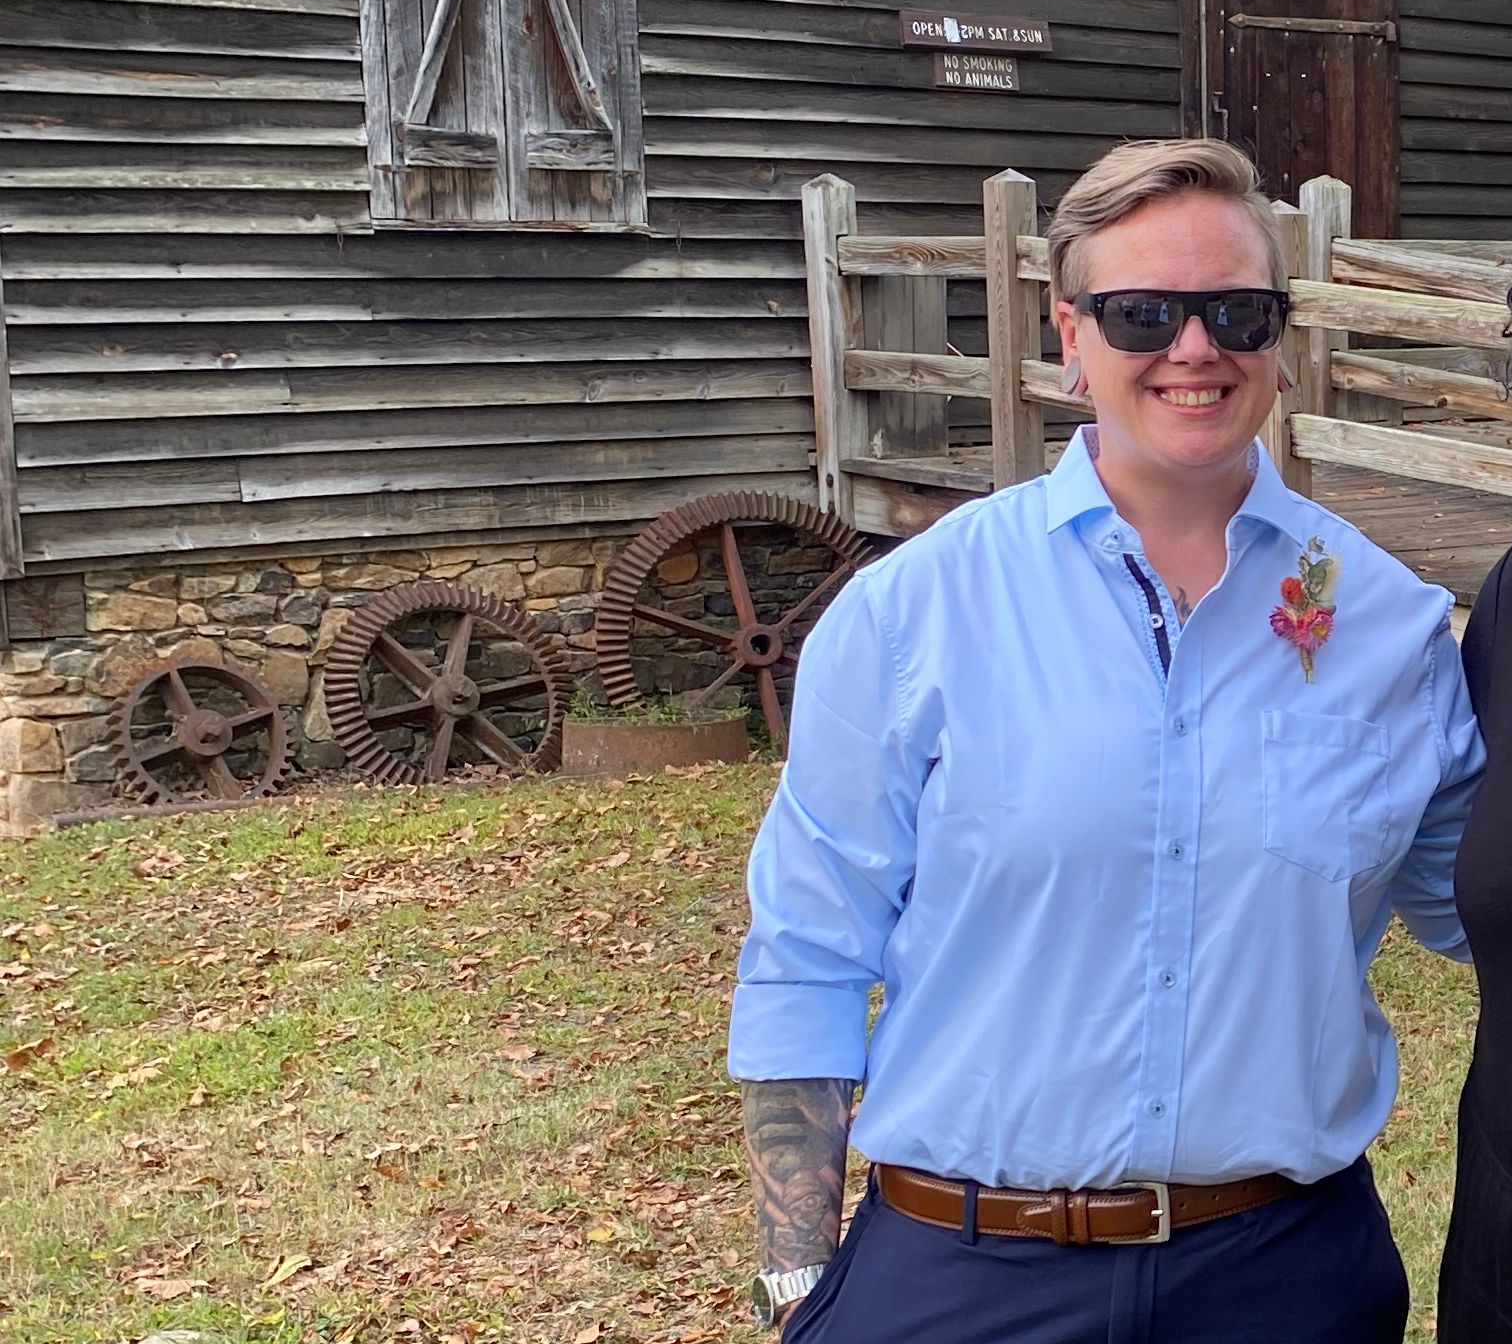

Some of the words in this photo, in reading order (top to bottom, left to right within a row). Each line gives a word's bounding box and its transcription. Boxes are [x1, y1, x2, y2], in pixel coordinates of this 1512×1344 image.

[944, 54, 958, 69] NO
[963, 56, 1012, 72] SMOKING
[945, 71, 960, 84] NO
[966, 72, 1012, 88] ANIMALS
